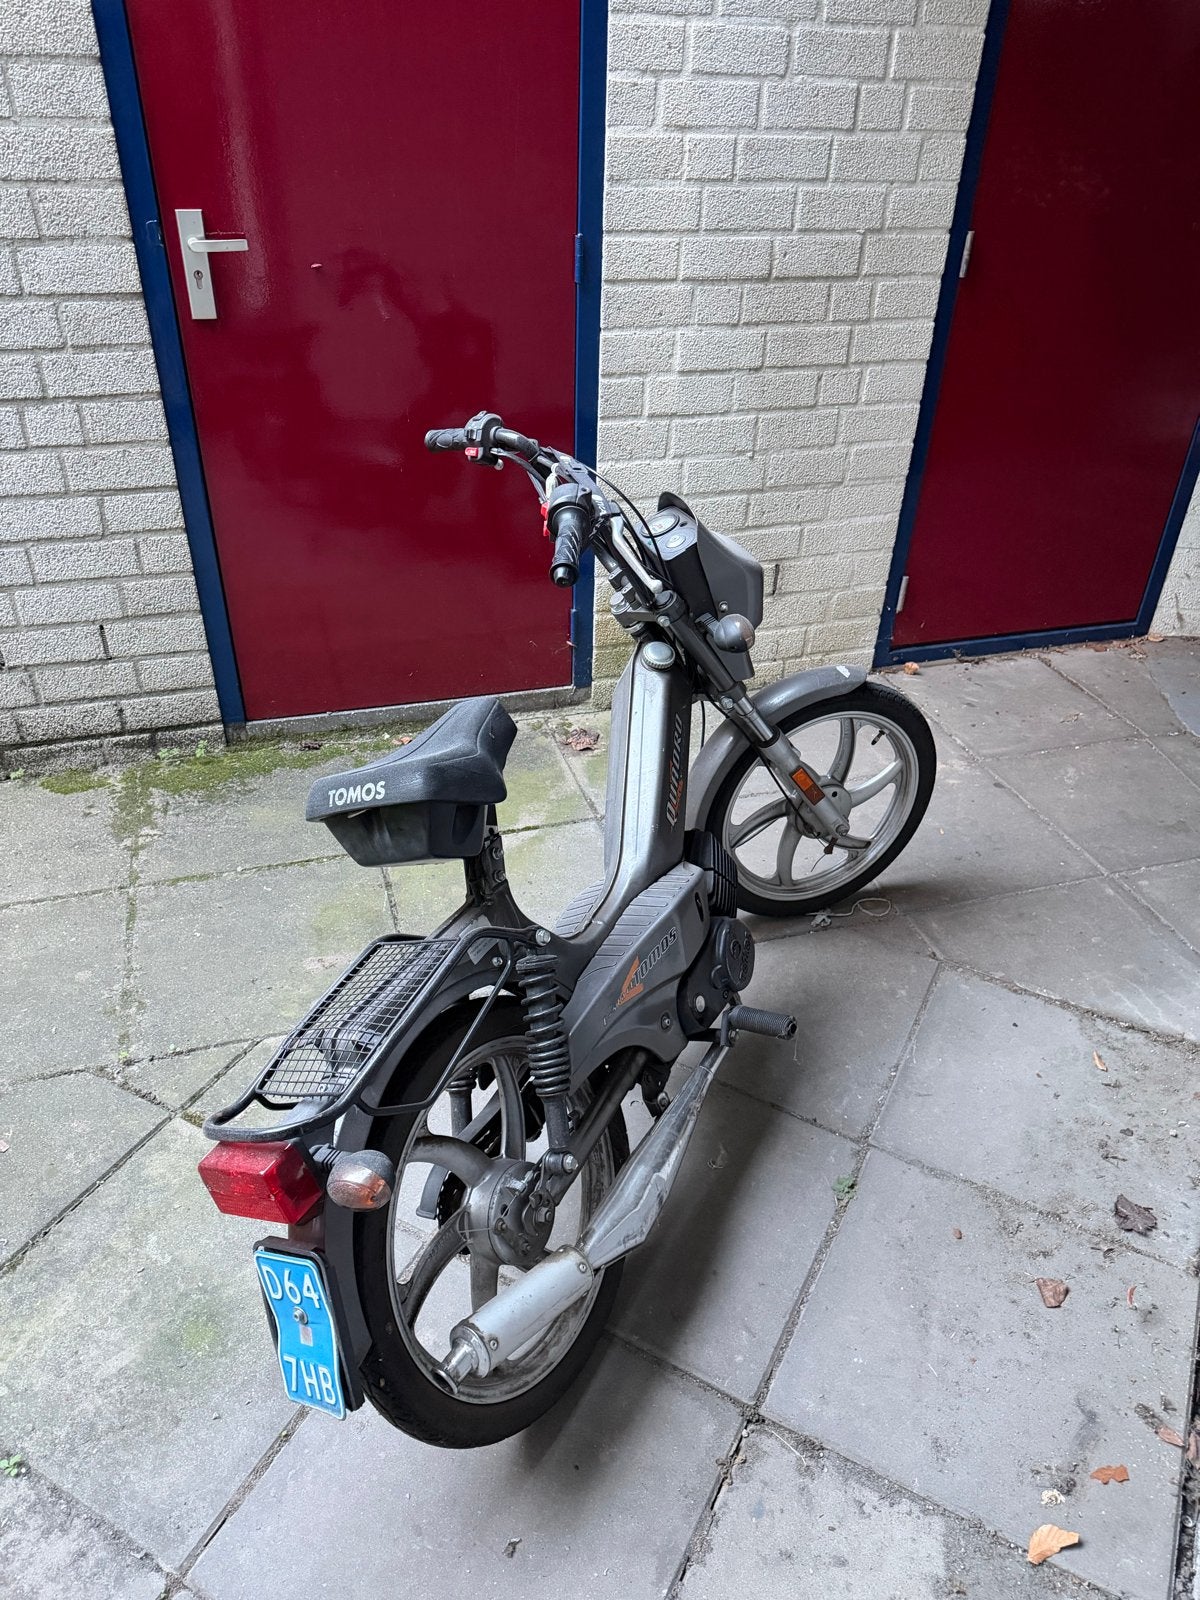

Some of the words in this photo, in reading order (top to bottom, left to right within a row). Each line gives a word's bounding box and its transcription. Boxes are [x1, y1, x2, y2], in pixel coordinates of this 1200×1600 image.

[328, 780, 386, 808] TOMOS
[633, 926, 679, 986] TOMOS
[262, 1265, 321, 1309] D64
[283, 1355, 336, 1405] 7HB
